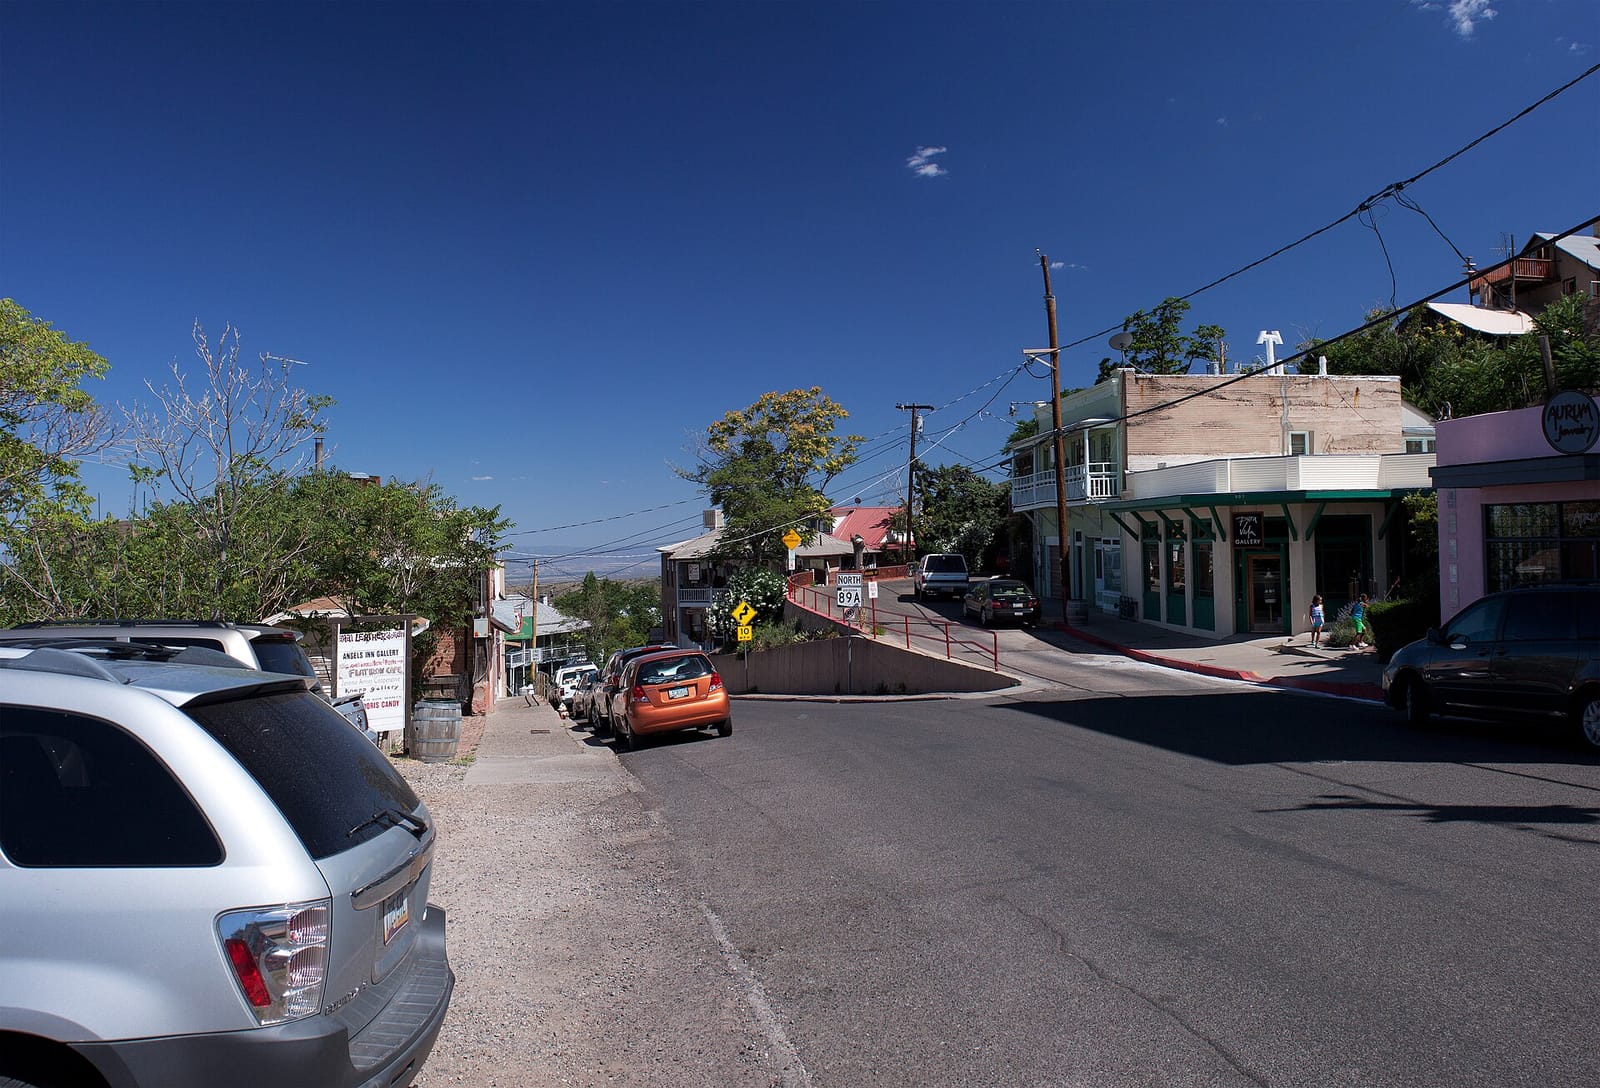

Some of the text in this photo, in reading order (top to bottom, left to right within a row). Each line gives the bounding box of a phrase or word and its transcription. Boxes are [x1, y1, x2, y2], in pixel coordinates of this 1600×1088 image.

[1547, 402, 1593, 431] AURUM
[837, 575, 861, 584] NORTH
[838, 592, 861, 604] 89A
[740, 627, 750, 635] 10
[376, 649, 399, 657] GALLERY
[382, 700, 399, 708] CANDY
